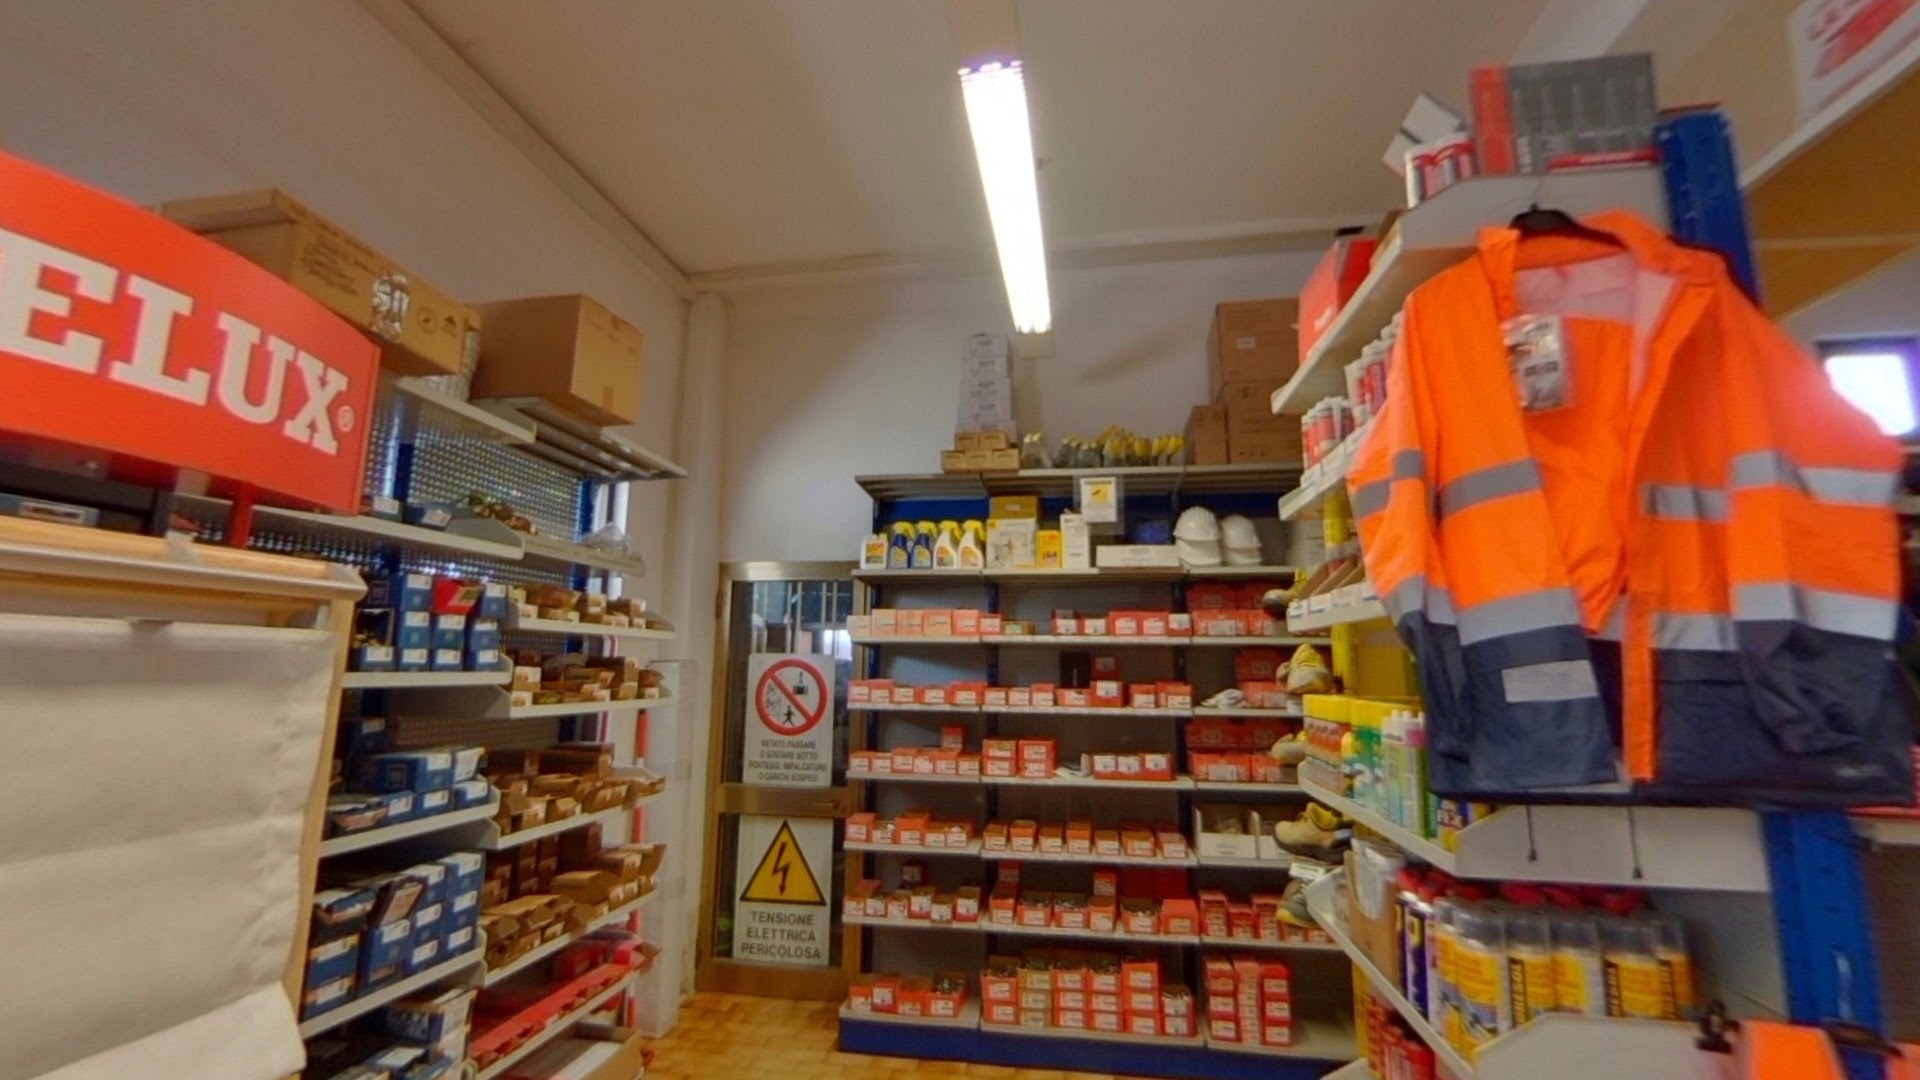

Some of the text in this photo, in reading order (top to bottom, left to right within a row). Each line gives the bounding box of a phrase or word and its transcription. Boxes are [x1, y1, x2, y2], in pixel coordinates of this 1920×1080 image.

[761, 739, 816, 749] VIETATO PASSARE
[766, 750, 794, 759] SOSTARE
[796, 752, 819, 760] SOTTO
[764, 772, 789, 780] CARICHI
[791, 773, 818, 781] SOSPESI
[751, 911, 814, 926] TENSIONE
[746, 926, 816, 942] ELETTRICA
[741, 942, 821, 959] PERICOLOSA
